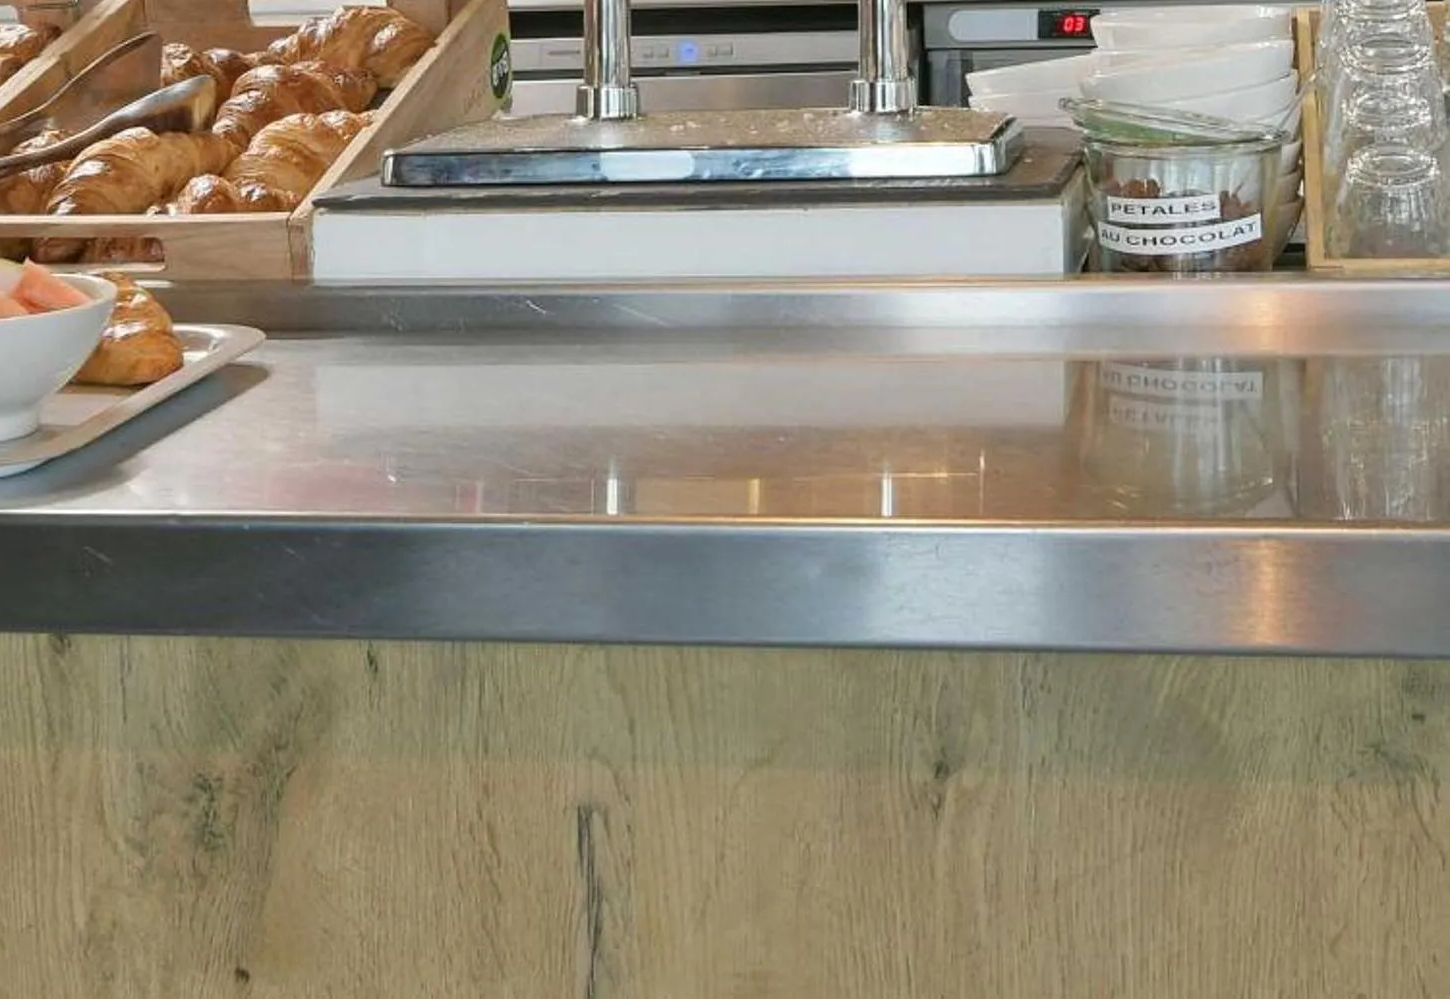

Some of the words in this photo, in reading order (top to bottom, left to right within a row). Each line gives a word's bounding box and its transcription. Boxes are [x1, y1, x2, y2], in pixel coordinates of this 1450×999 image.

[1111, 199, 1217, 215] PETALES
[1101, 229, 1121, 243] AU
[1126, 222, 1258, 246] CHOCOLAT
